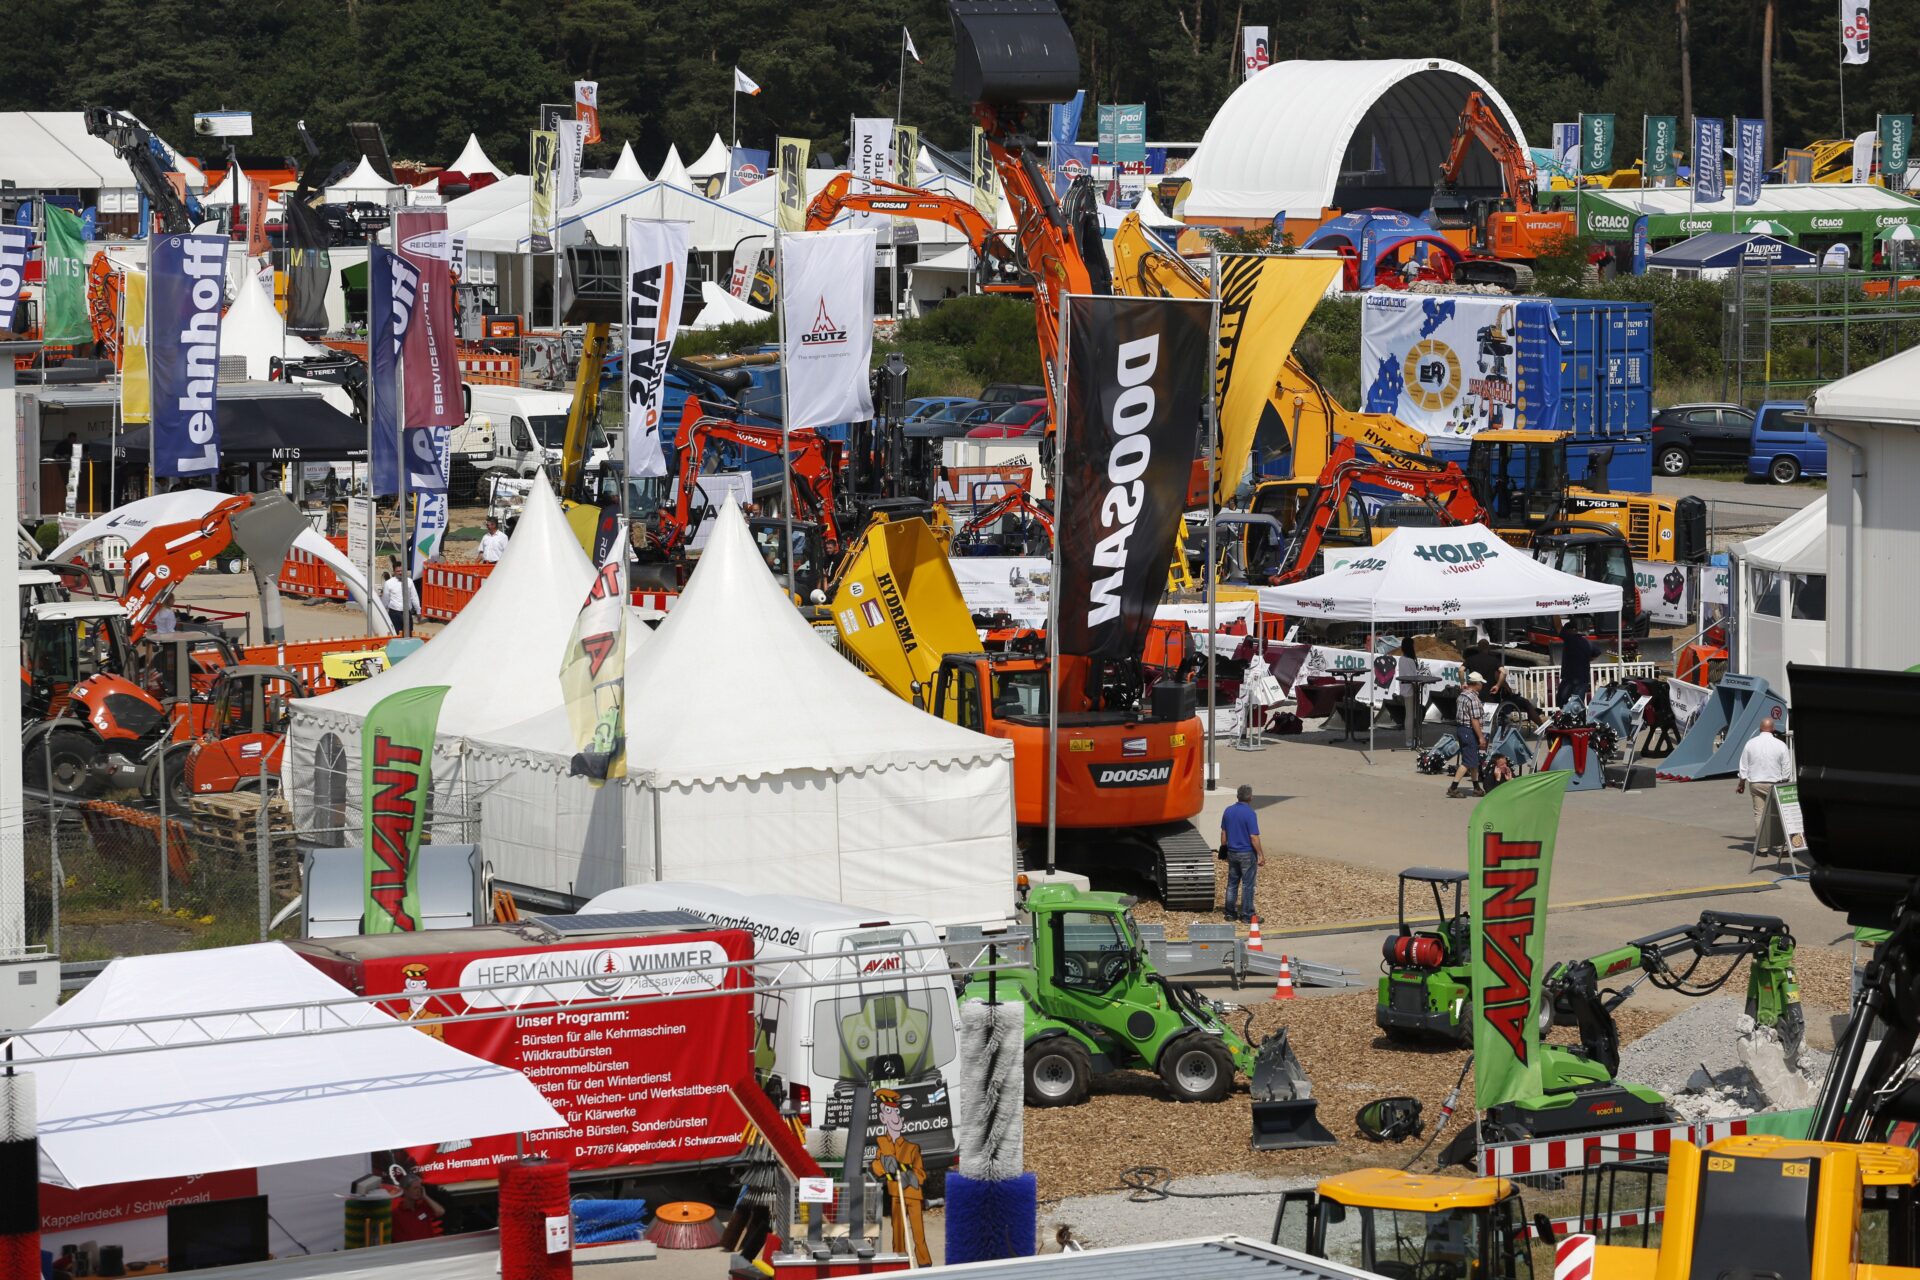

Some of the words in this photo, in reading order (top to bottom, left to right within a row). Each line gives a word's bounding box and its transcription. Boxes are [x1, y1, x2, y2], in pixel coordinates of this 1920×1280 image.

[1255, 38, 1268, 71] IPO
[1120, 111, 1142, 125] paal
[1593, 118, 1603, 159] CRACO
[1656, 121, 1667, 162] CRACO
[1892, 119, 1902, 160] CRACO
[1698, 123, 1713, 197] Dappen
[1738, 124, 1754, 201] Dappen
[733, 170, 764, 181] LAUDON
[861, 134, 873, 218] CVENTION
[1059, 166, 1088, 175] LAUDON
[1525, 222, 1562, 231] HITACHI
[1595, 215, 1630, 229] CRACO
[1686, 219, 1713, 229] CRACO
[1817, 218, 1844, 227] CRACO
[1883, 216, 1908, 225] CRACO
[451, 238, 464, 277] CHI
[1745, 242, 1782, 256] Dappen
[801, 330, 848, 342] DEUTZ
[178, 238, 227, 473] Lehnhoff
[314, 368, 337, 376] TEREX
[736, 430, 767, 447] Kubota
[1383, 474, 1415, 491] Kubota
[1662, 530, 1672, 540] 40
[1413, 541, 1499, 564] HOLP
[157, 566, 169, 578] 20
[877, 573, 919, 655] HYDREMA
[1334, 655, 1365, 669] HOLP
[1099, 766, 1170, 783] DOOSAN
[370, 733, 425, 932] AVANT
[676, 905, 800, 947] www.avanttecno.de
[1482, 831, 1543, 1069] AVANT
[477, 958, 579, 985] HERMANN
[628, 949, 713, 971] WIMMER
[862, 956, 901, 974] AVANT
[516, 1015, 553, 1029] Unser
[556, 1009, 630, 1027] Programm:
[522, 1031, 564, 1046] Bürsten
[566, 1030, 581, 1044] für
[583, 1029, 603, 1042] alle
[605, 1022, 686, 1040] Kehrmaschinen
[522, 1046, 612, 1062] Wildkrautbürsten
[522, 1060, 629, 1078] Siebtrommelbürsten
[532, 1080, 565, 1093] ürsten
[567, 1078, 582, 1091] für
[585, 1078, 605, 1089] den
[607, 1071, 672, 1088] Winterdienst
[576, 1093, 626, 1106] Weichen-
[628, 1091, 648, 1102] und
[567, 1112, 582, 1122] für
[585, 1106, 637, 1121] Klärwerke
[523, 1126, 584, 1143] Technische
[586, 1122, 630, 1138] Bürsten,
[631, 1115, 708, 1132] Sonderbürsten
[575, 1144, 614, 1157] D-77876
[615, 1138, 677, 1153] Kappelrodeck
[684, 1131, 742, 1148] Schwarzwald
[446, 1156, 489, 1170] Hermann
[490, 1152, 533, 1164] Wimer
[41, 1206, 124, 1231] Kappelrodeck
[134, 1190, 212, 1214] Schwarzwald
